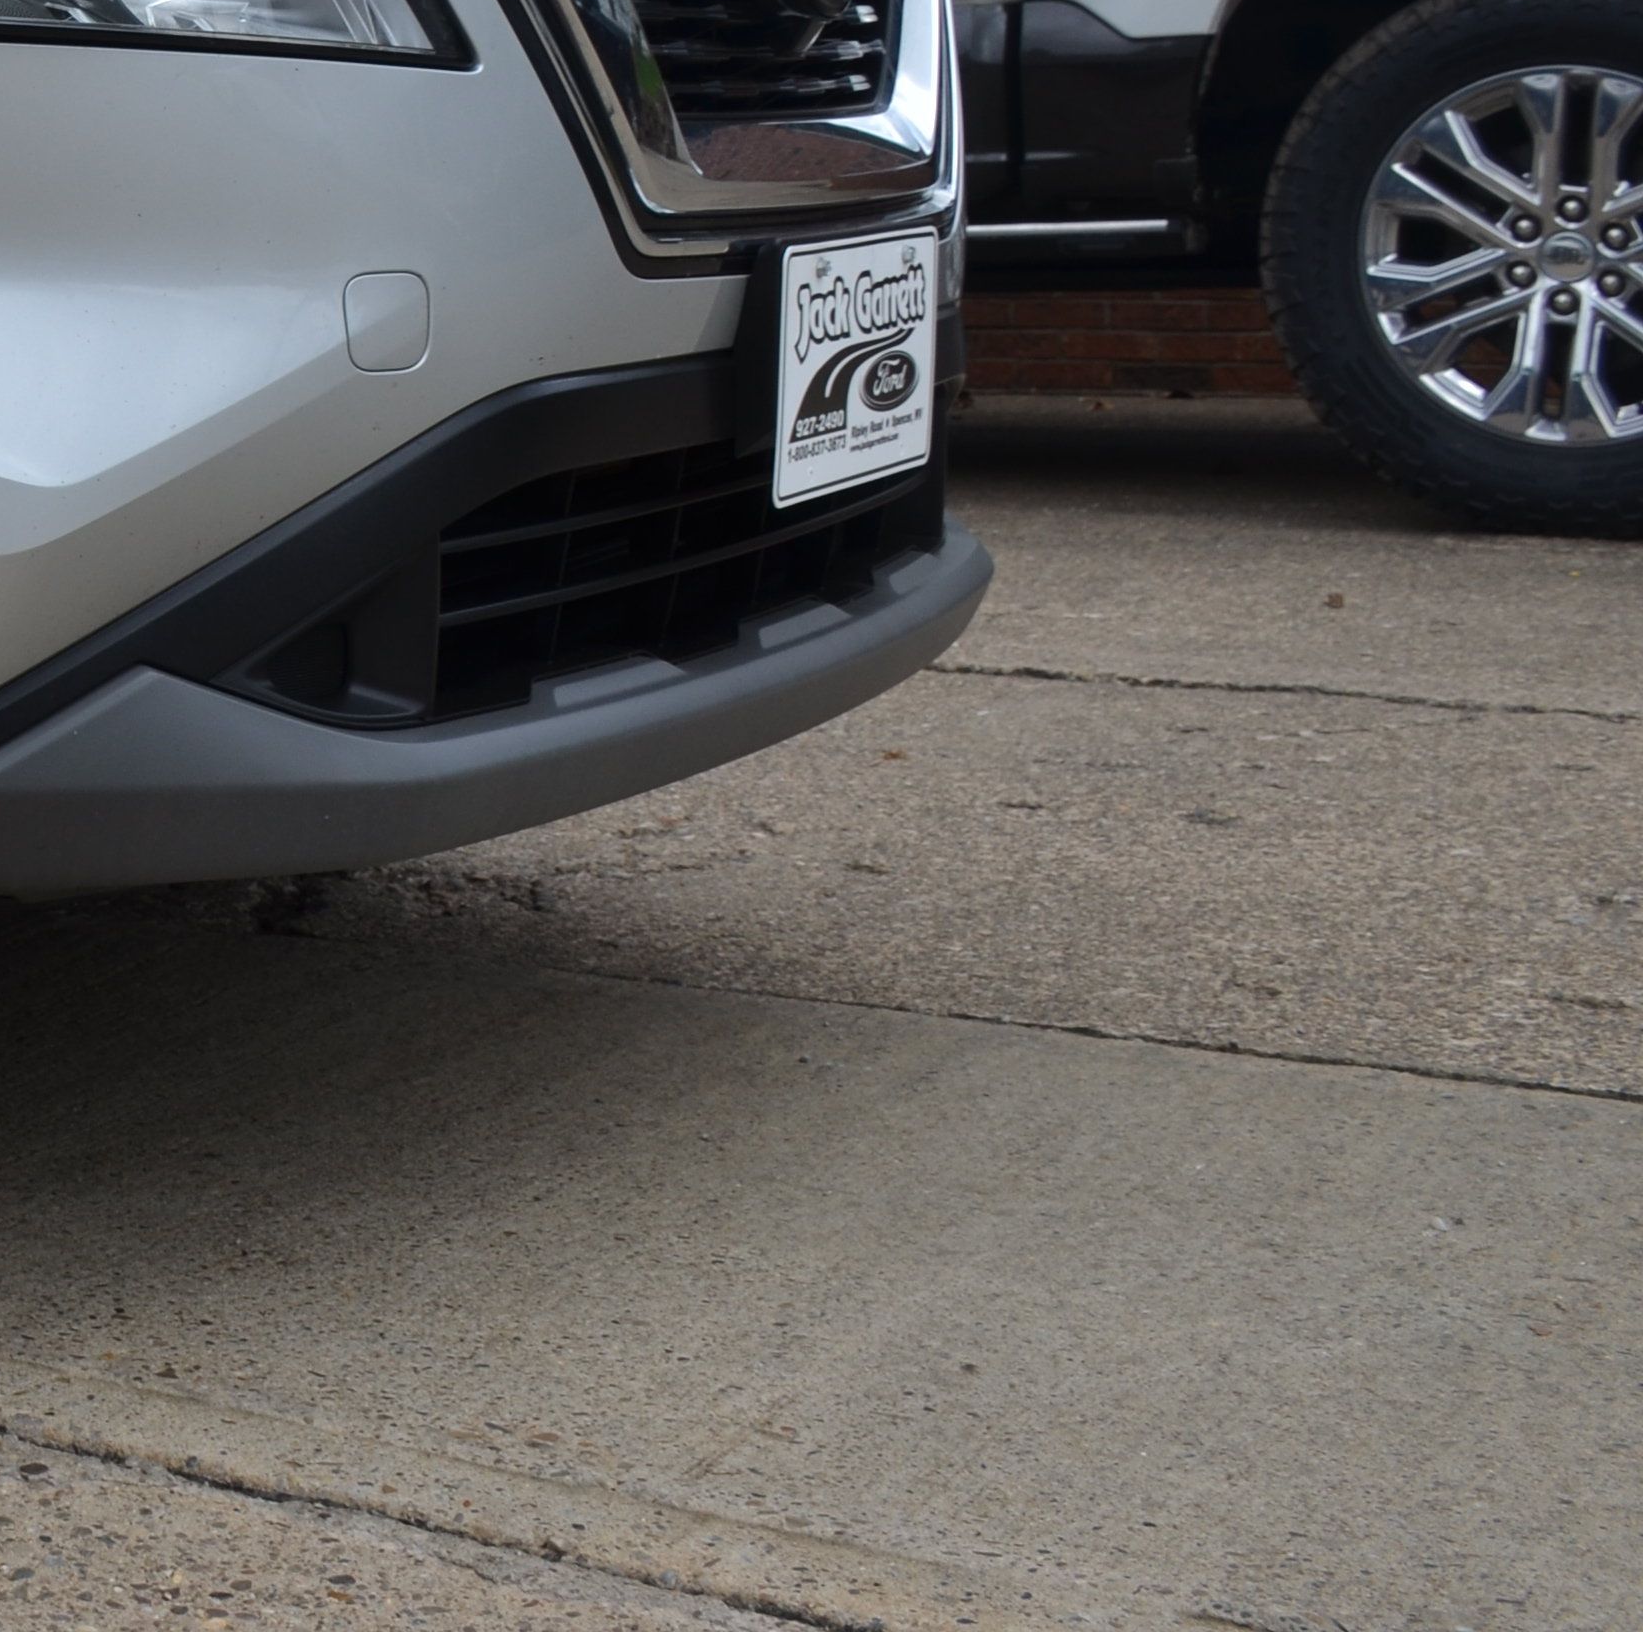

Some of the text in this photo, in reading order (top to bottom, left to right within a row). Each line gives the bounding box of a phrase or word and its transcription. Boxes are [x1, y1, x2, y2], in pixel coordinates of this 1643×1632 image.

[794, 264, 925, 365] Jack Garrett
[873, 358, 908, 396] Ford
[795, 409, 845, 438] 927-2490
